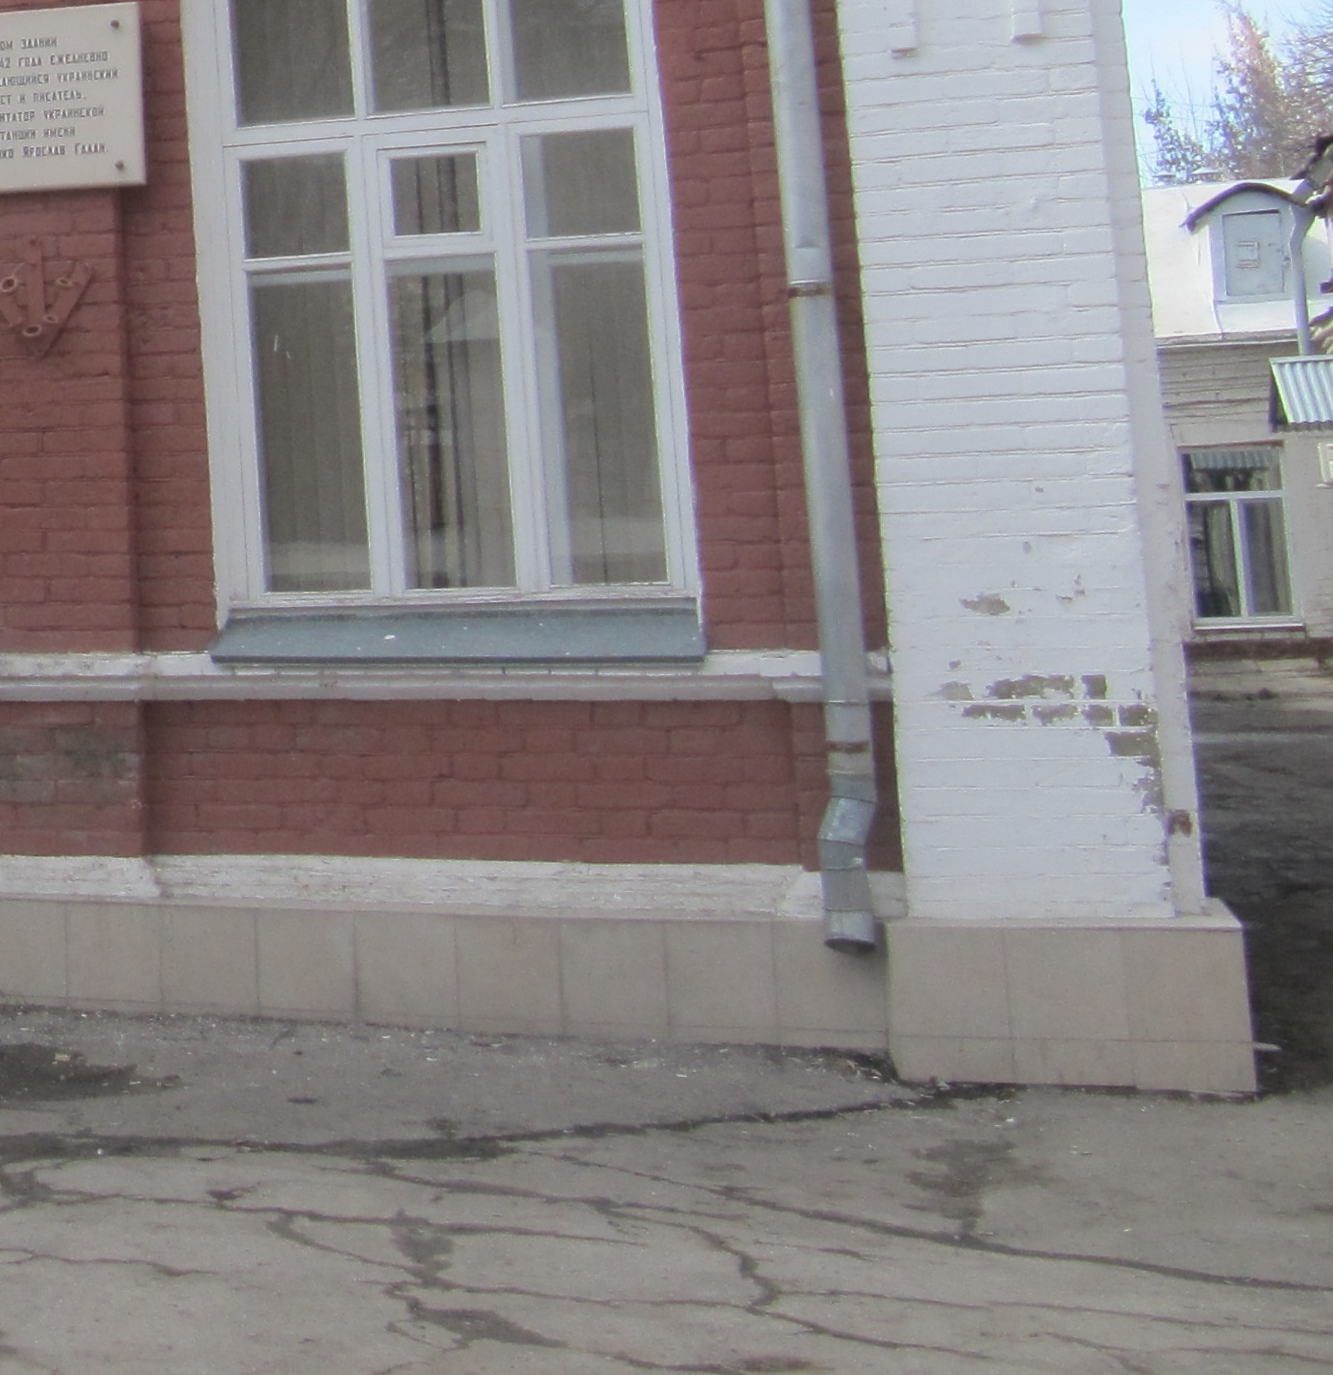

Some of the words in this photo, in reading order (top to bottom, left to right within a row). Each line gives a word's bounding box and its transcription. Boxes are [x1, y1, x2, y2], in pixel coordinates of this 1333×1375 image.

[21, 37, 57, 49] ЗДАНИИ
[18, 56, 42, 67] ГОДА
[51, 51, 108, 64] ЕЖЕДНЕВНО
[57, 69, 118, 82] УКРАИНСКИЙ
[20, 94, 26, 103] И
[43, 106, 104, 119] УКРАИНСКОЙ
[43, 127, 75, 137] ИМЕНИ
